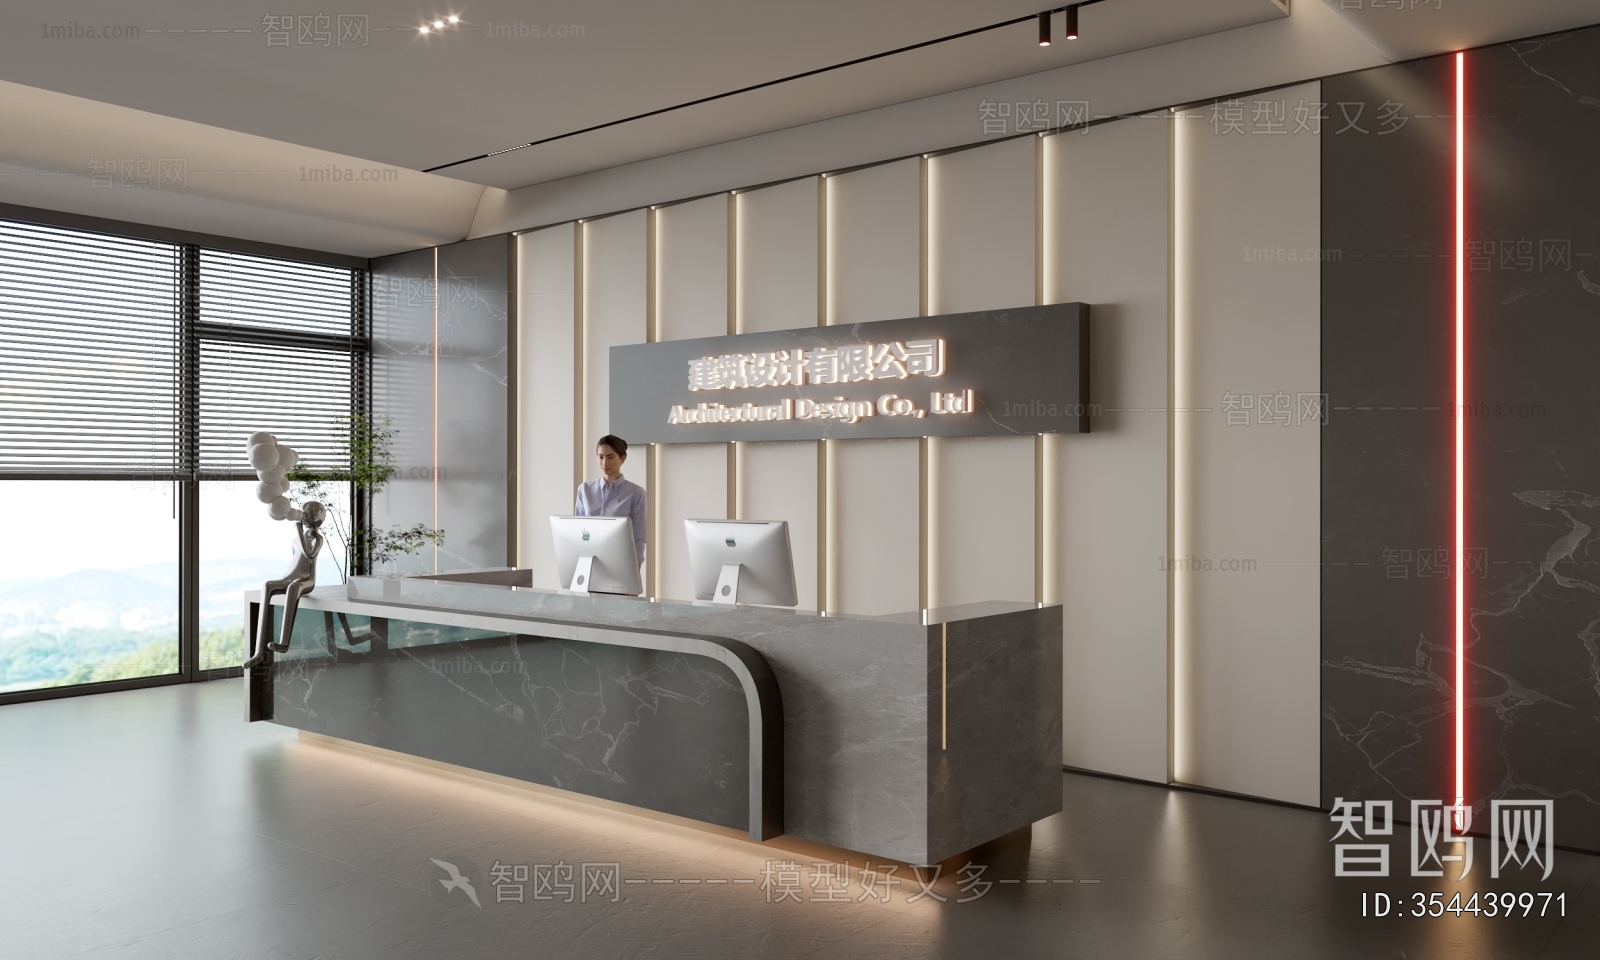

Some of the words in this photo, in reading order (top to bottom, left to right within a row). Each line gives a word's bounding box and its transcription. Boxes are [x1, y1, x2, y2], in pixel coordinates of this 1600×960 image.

[687, 338, 946, 392] 建筑设计有限公司
[667, 398, 794, 424] Architectural
[795, 396, 874, 424] Design
[876, 393, 927, 419] Co.,
[930, 389, 974, 414] Ltd
